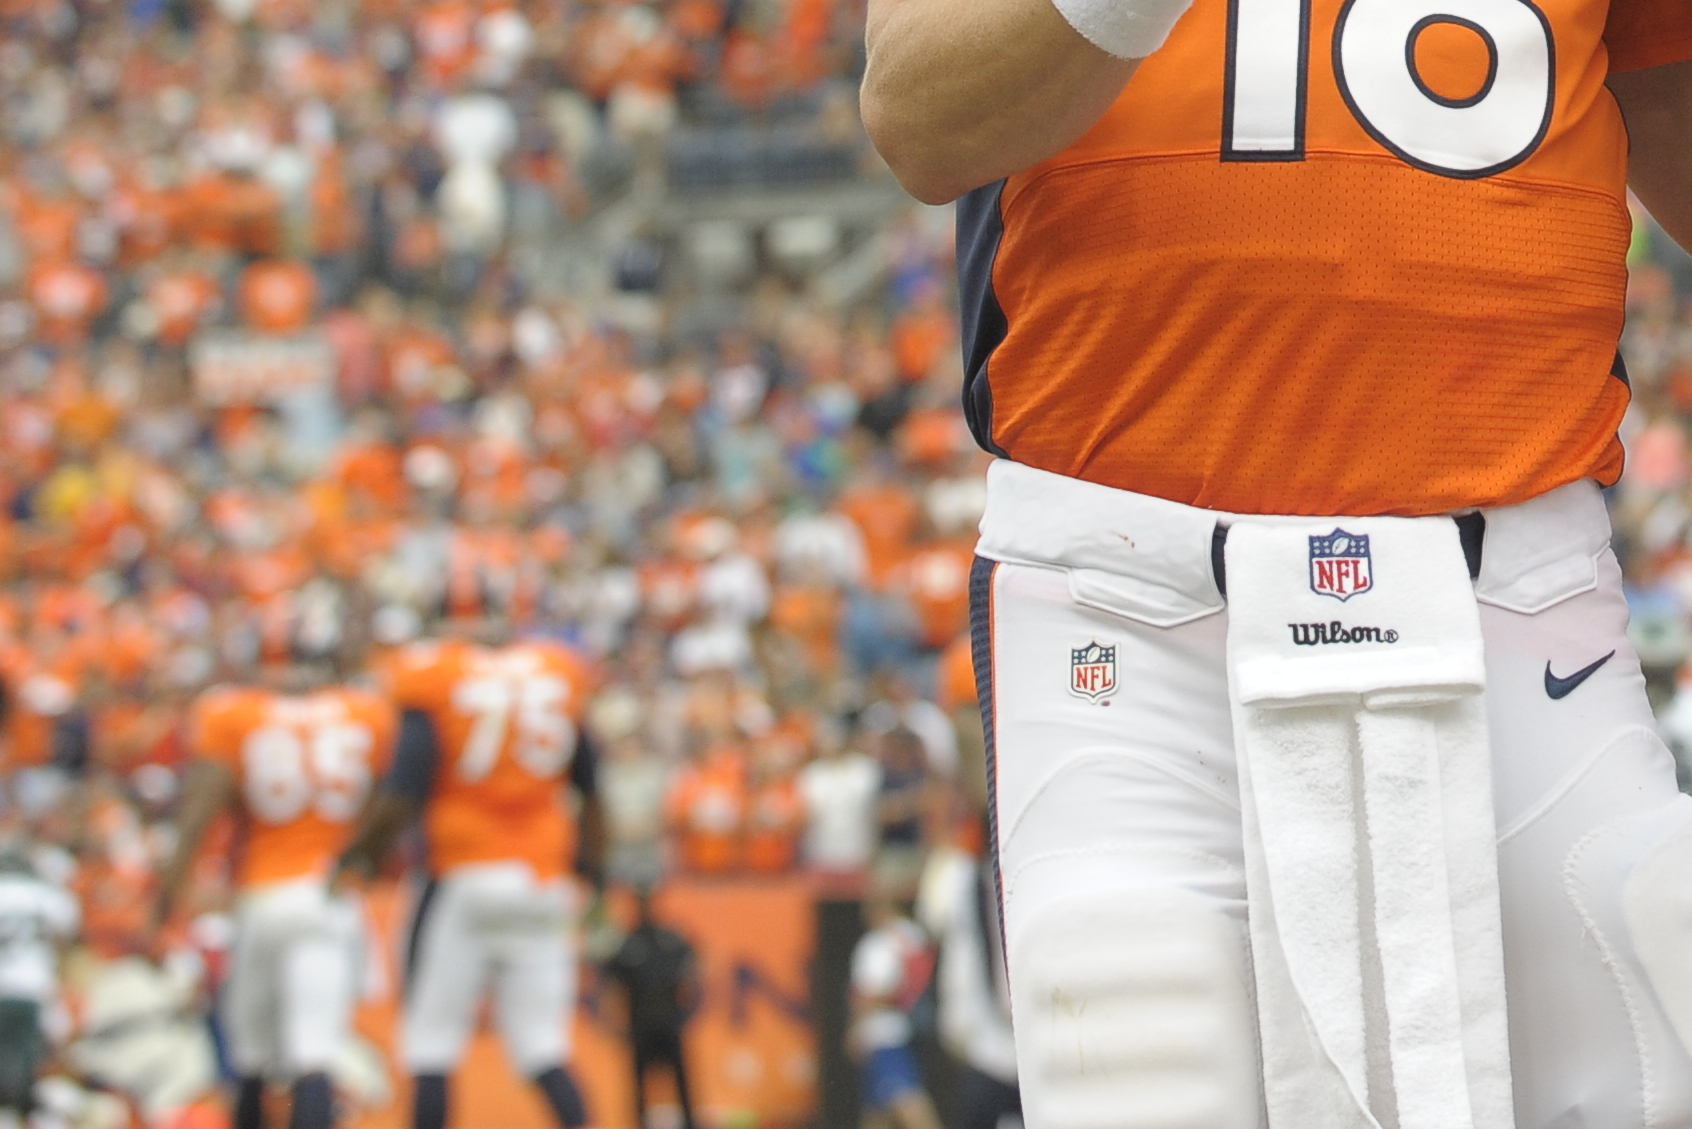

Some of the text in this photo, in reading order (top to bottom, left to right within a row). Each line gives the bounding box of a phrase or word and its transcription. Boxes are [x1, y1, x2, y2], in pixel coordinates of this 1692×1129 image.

[1315, 559, 1368, 594] NFL
[1075, 665, 1112, 691] NFL
[449, 672, 577, 784] 75
